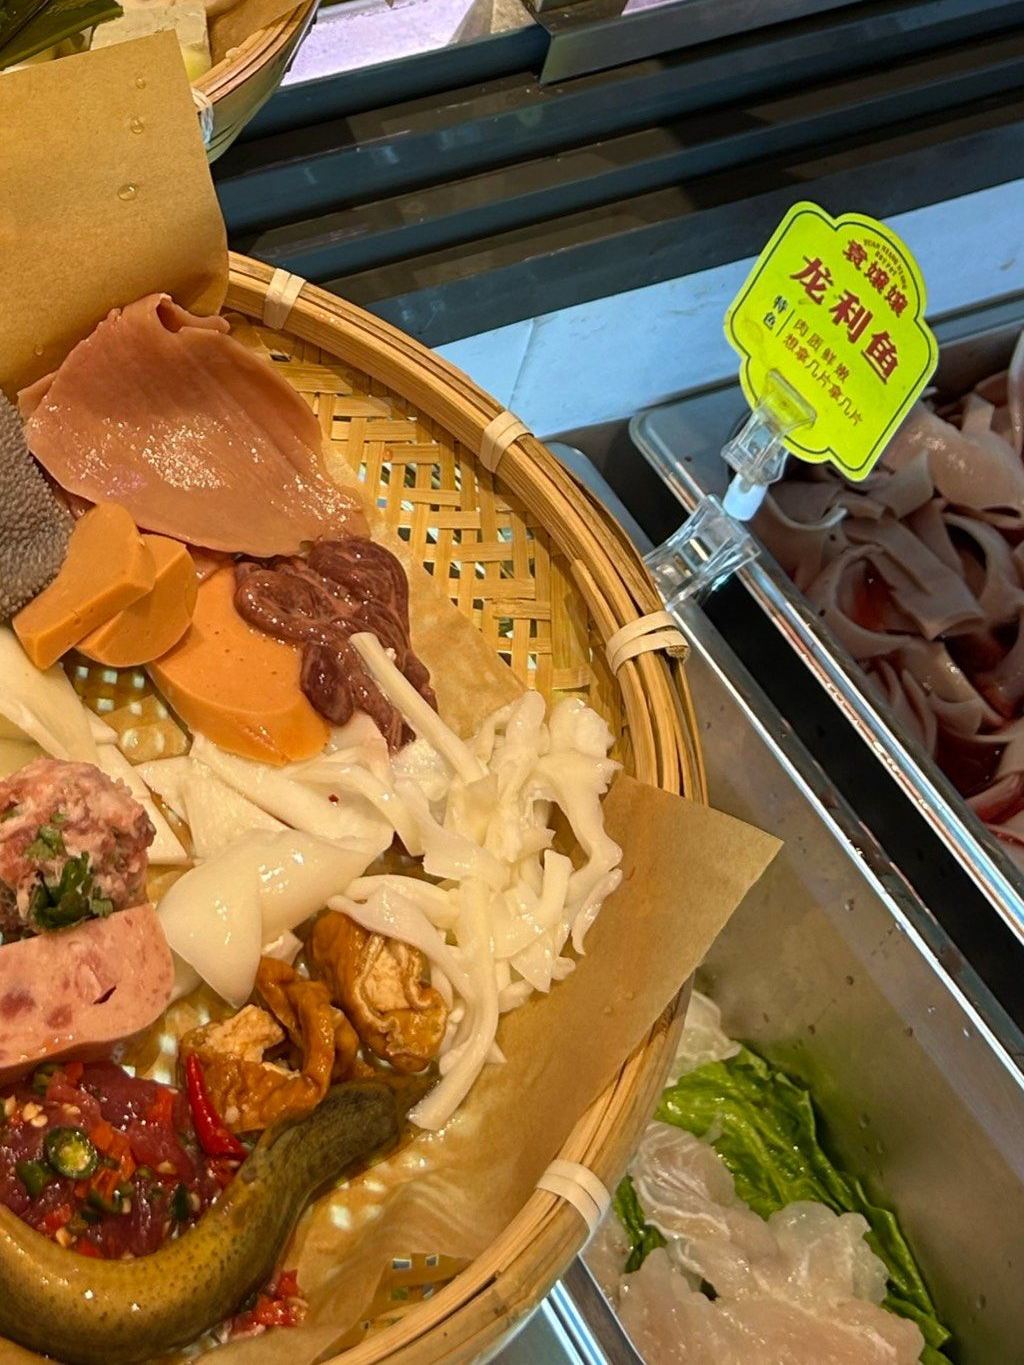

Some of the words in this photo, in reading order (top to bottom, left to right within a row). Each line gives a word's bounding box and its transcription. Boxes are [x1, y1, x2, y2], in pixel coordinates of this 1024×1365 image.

[762, 295, 788, 332] 特色
[789, 255, 898, 385] 龙利鱼
[793, 318, 850, 385] 肉质鲜嫩
[783, 333, 863, 427] 想拿几片拿几片
